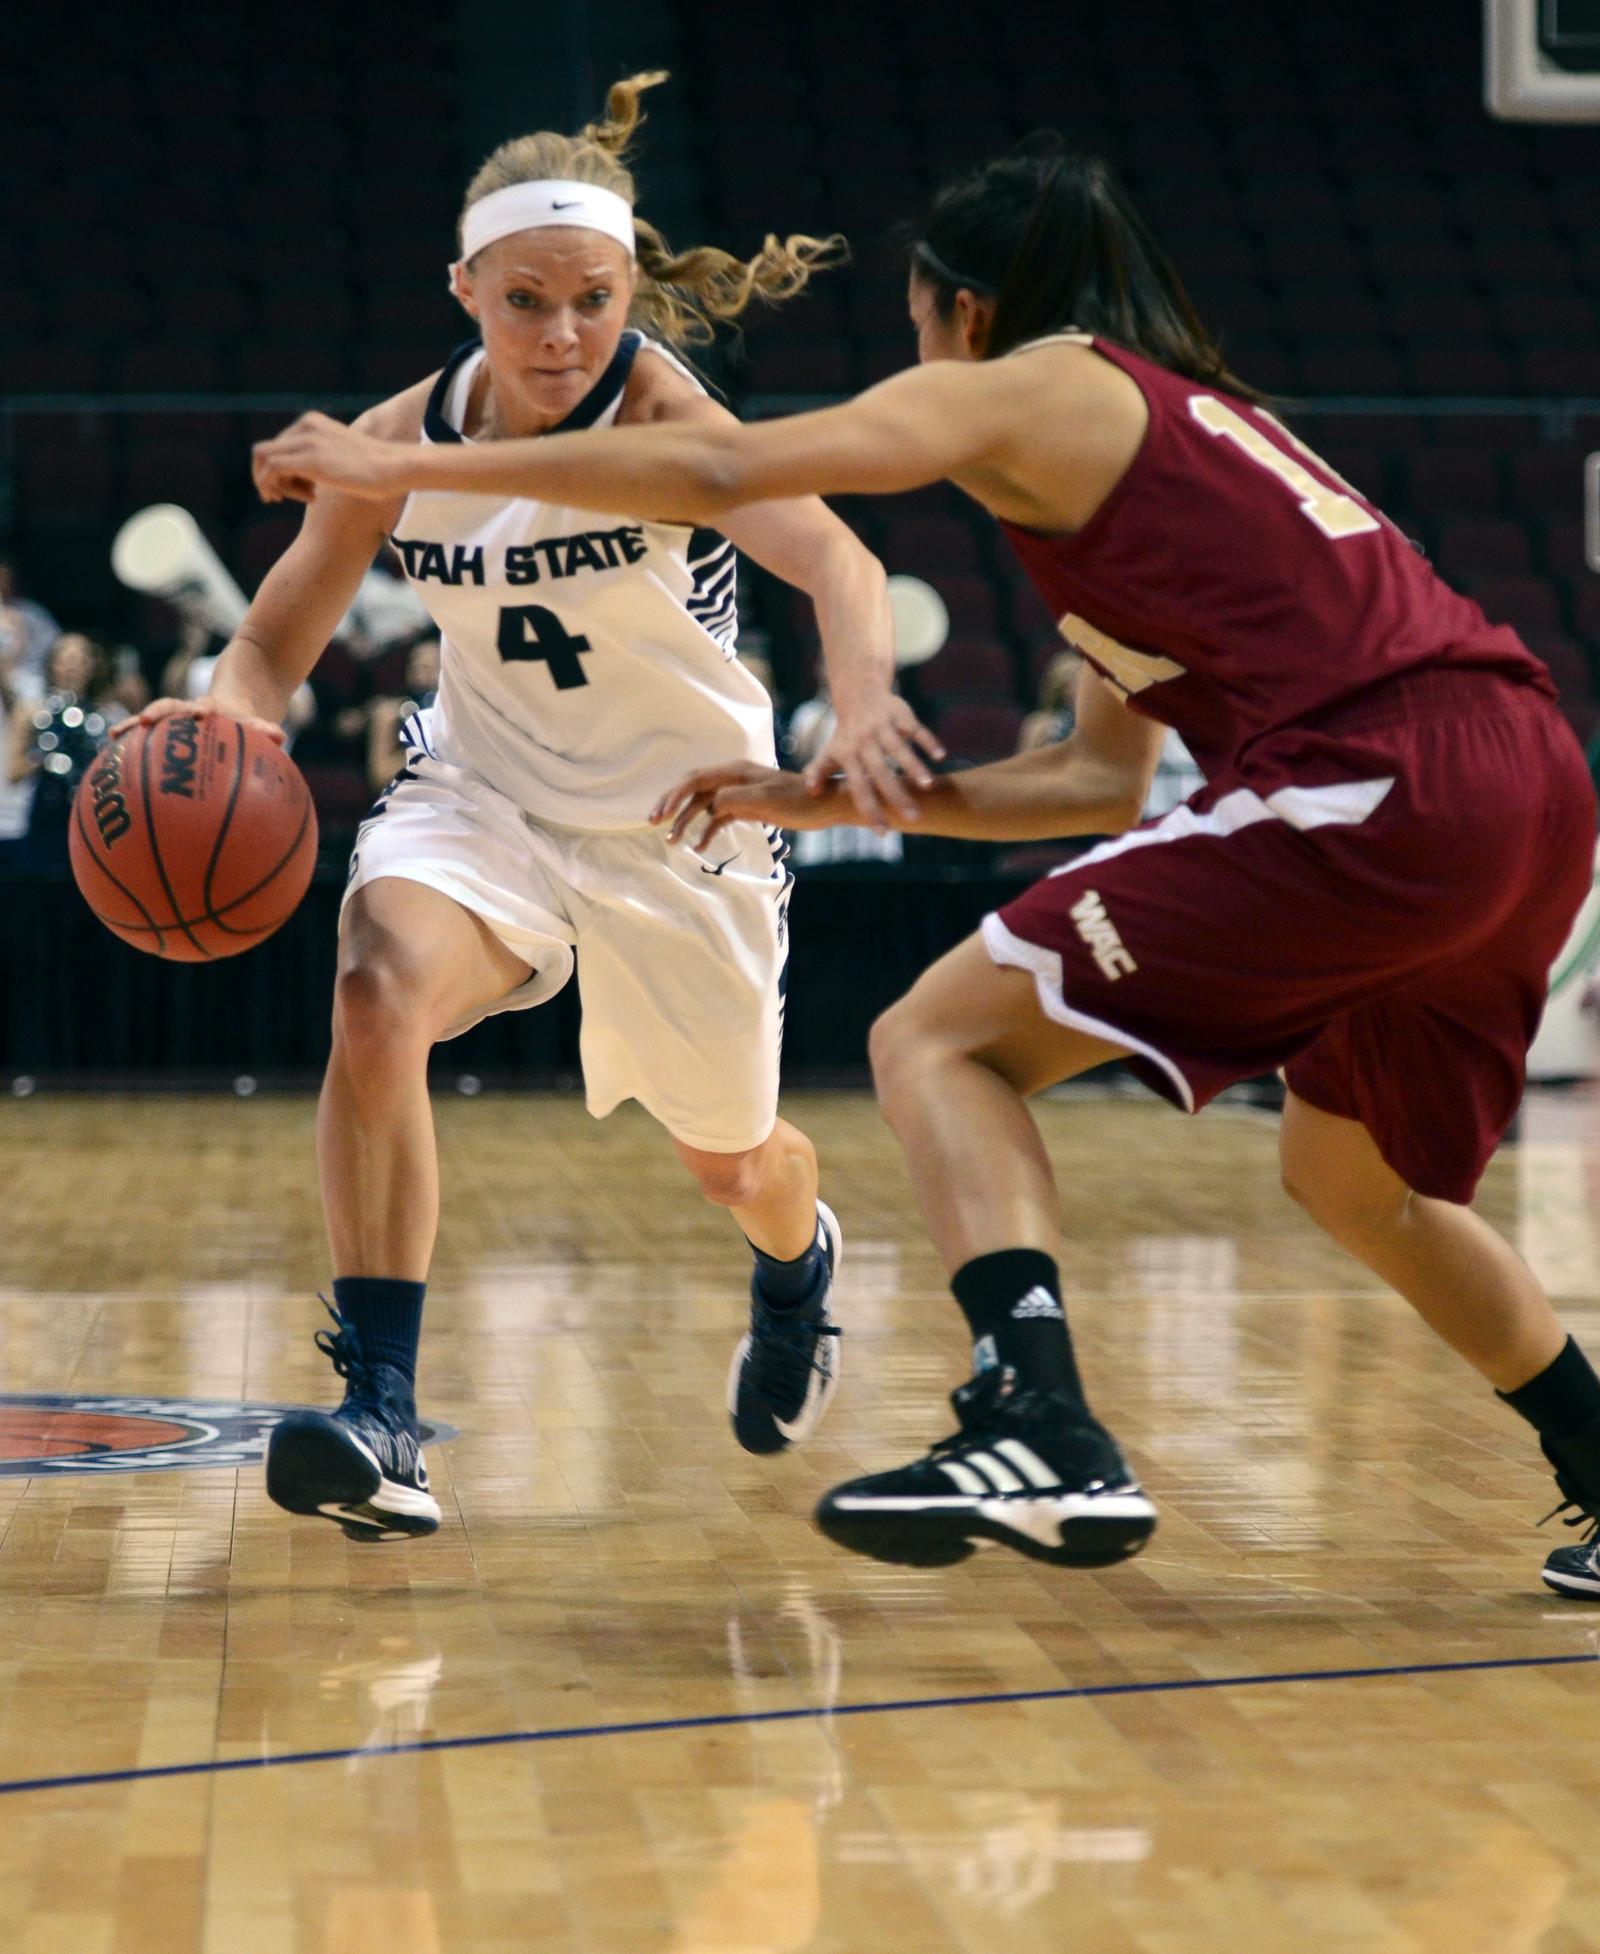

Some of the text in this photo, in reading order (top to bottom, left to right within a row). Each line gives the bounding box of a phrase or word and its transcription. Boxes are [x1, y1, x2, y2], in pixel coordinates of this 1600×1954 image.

[1188, 395, 1381, 540] 1
[390, 525, 648, 587] TAH STATE
[497, 604, 592, 690] 4
[90, 743, 131, 851] Wil
[1070, 890, 1139, 982] WAC
